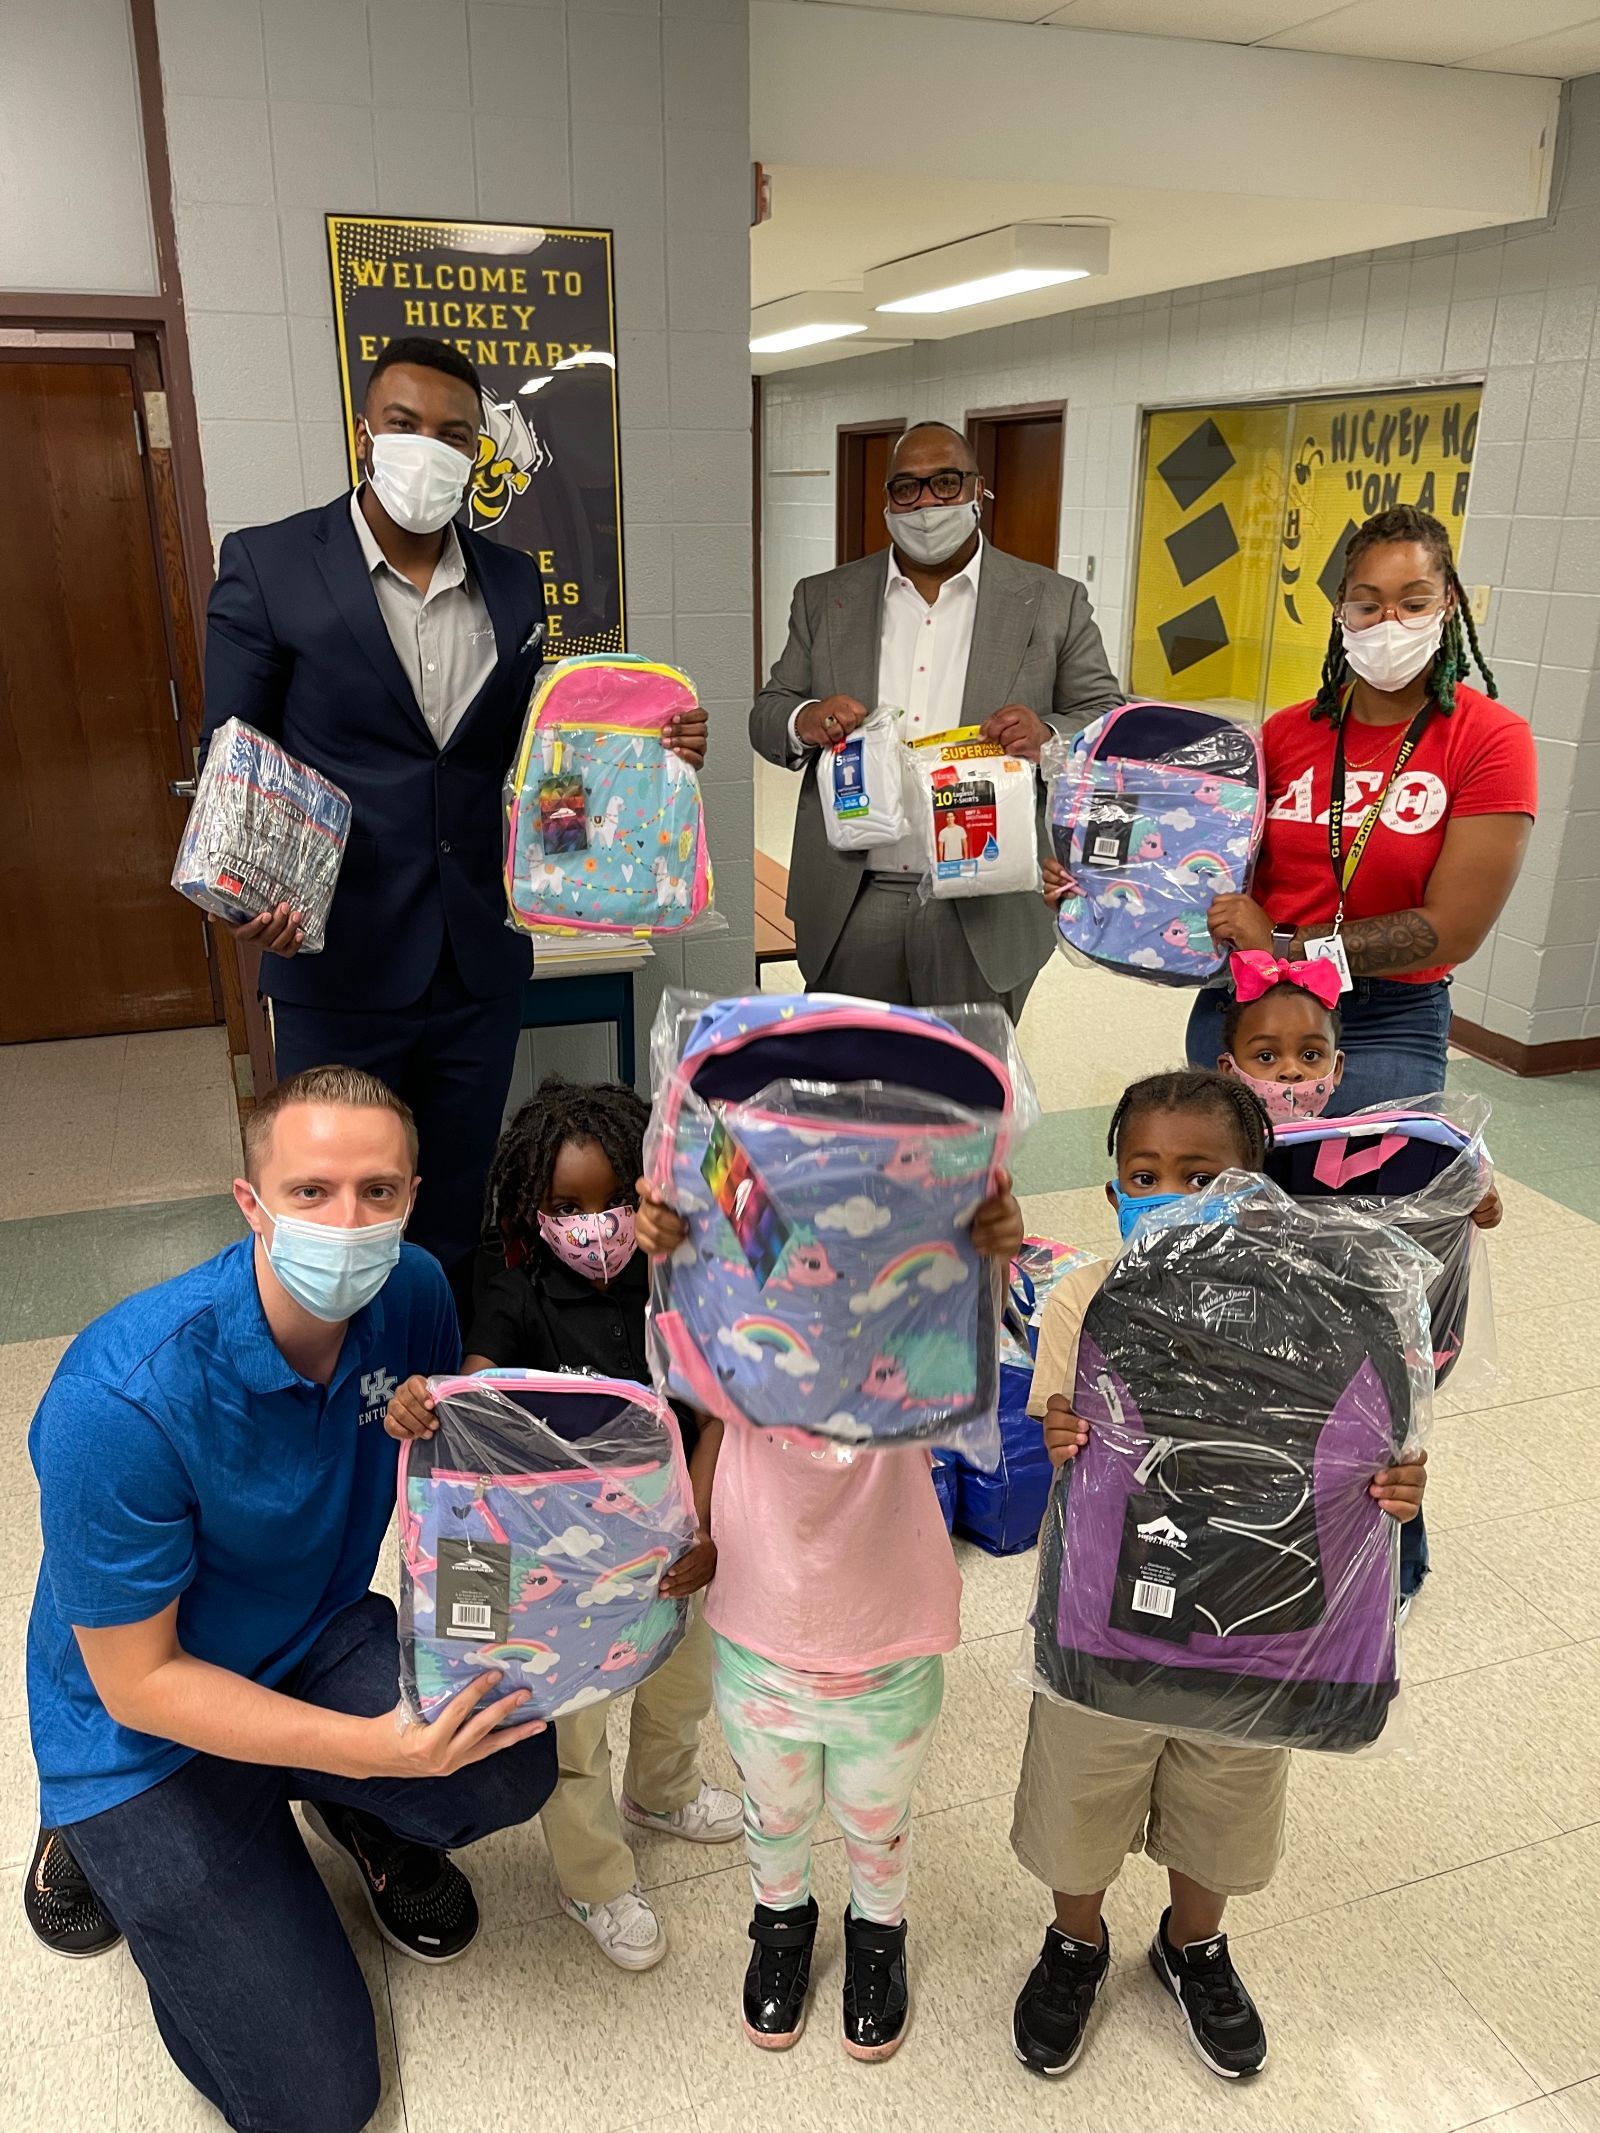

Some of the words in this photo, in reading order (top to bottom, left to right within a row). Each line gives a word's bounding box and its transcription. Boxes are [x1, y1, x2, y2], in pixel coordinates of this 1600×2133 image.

[350, 261, 528, 294] WELCOME
[542, 270, 583, 296] TO
[404, 300, 536, 331] HICKEY
[359, 335, 592, 368] EENTARY
[1331, 406, 1430, 466] HICKEY
[1442, 402, 1479, 464] HO
[1415, 471, 1435, 513] A
[1451, 471, 1471, 517] R
[836, 756, 843, 766] 5
[942, 745, 983, 760] SUPER
[935, 792, 953, 806] 10
[1331, 800, 1343, 859] Garrett
[360, 1367, 397, 1407] UK
[358, 1406, 387, 1426] ENTU
